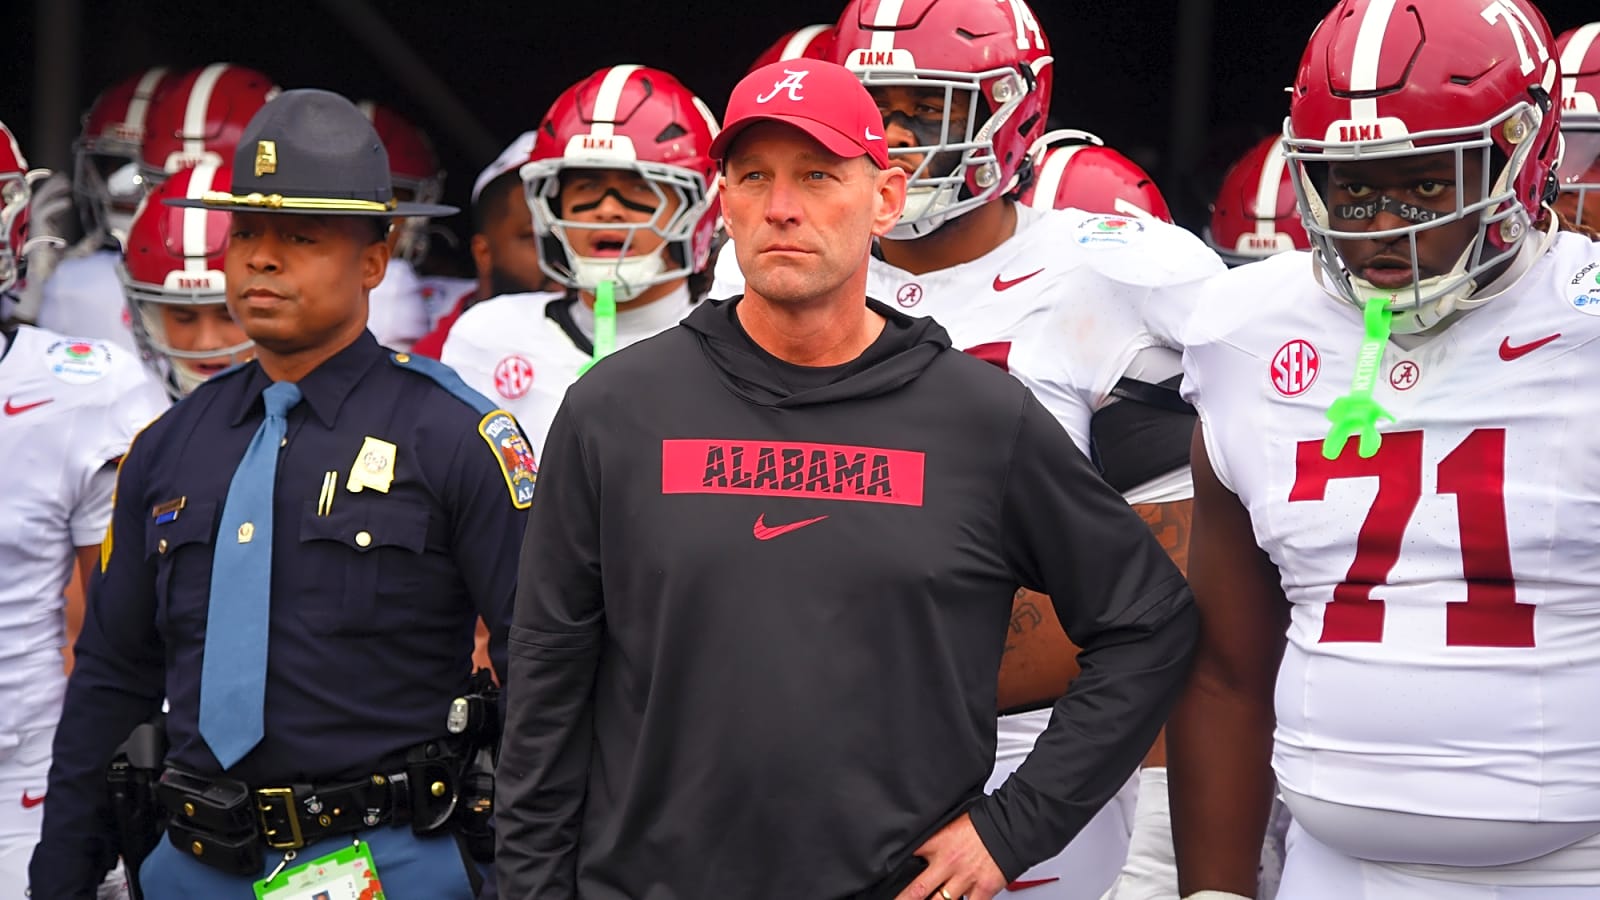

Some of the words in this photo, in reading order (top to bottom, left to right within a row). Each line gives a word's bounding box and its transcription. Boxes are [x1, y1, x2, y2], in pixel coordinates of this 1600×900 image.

[859, 51, 894, 66] BAMA
[1480, 0, 1549, 77] 71
[756, 68, 809, 104] A
[1339, 124, 1383, 143] BAMA
[496, 356, 533, 398] SEC
[1273, 340, 1317, 394] SEC
[702, 445, 893, 498] ALABAMA
[1288, 428, 1537, 648] 71
